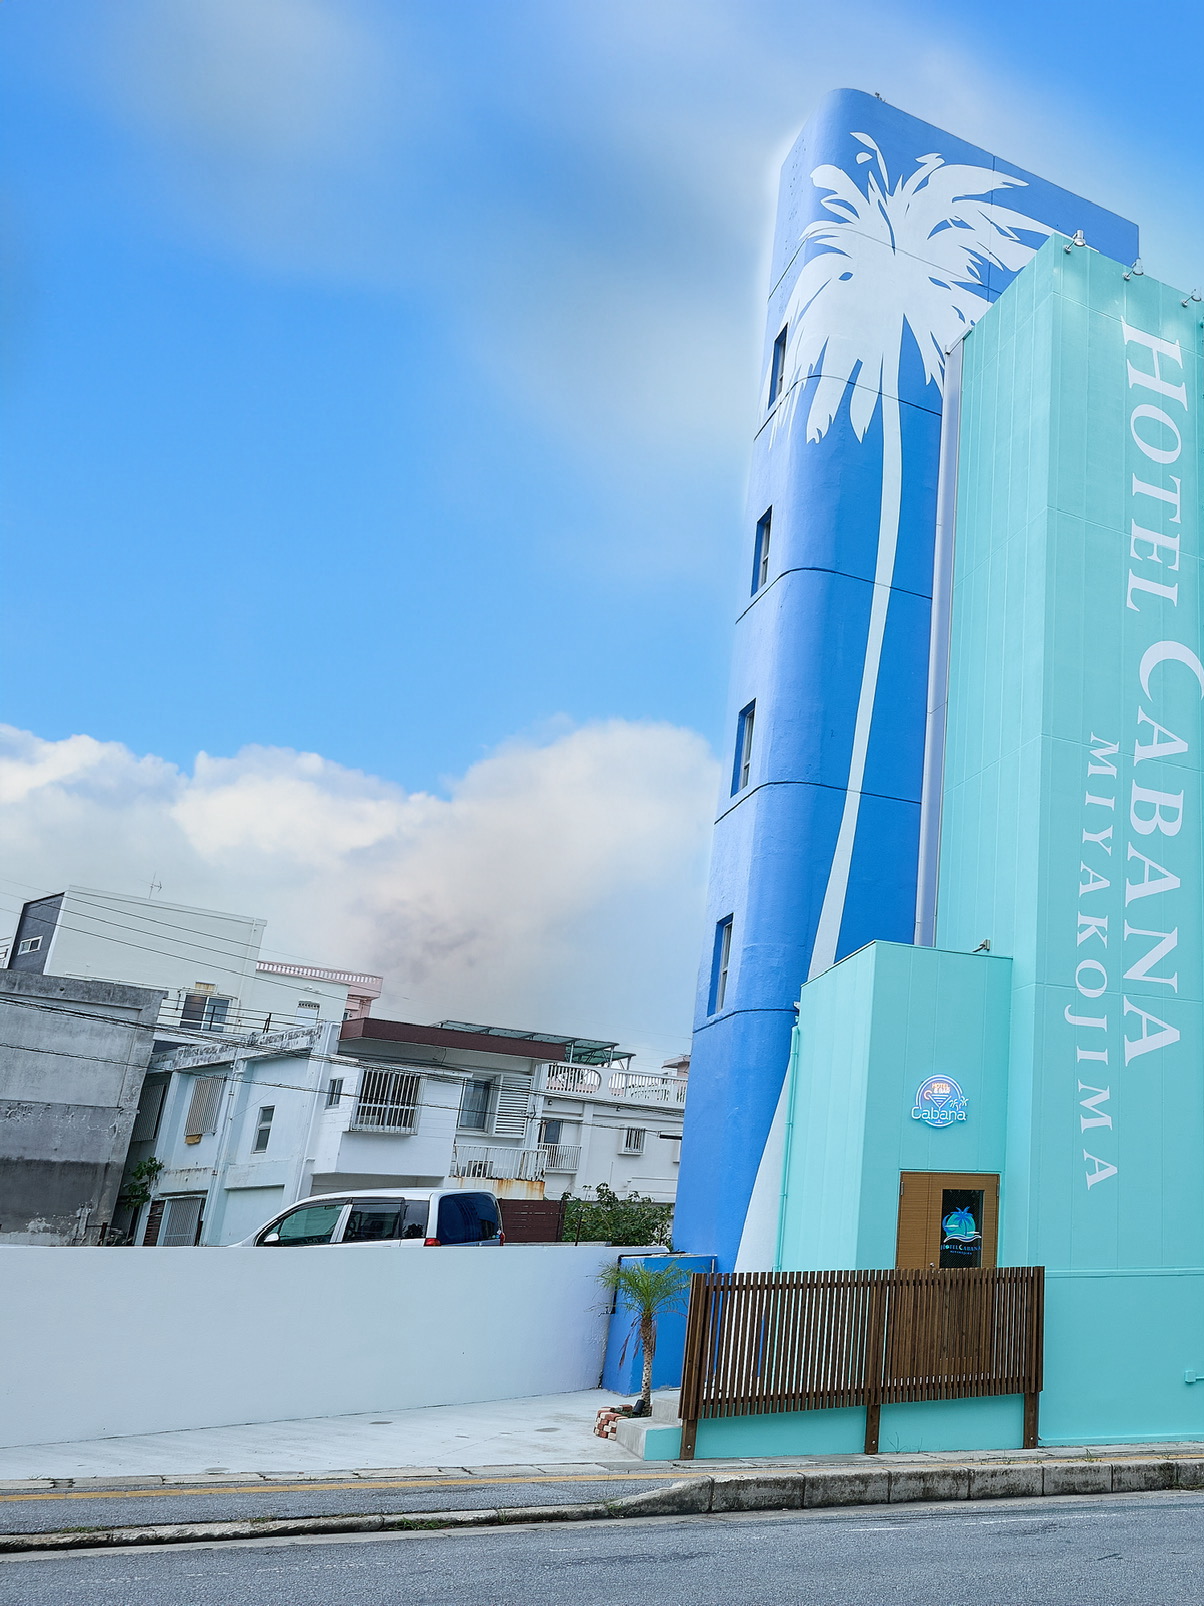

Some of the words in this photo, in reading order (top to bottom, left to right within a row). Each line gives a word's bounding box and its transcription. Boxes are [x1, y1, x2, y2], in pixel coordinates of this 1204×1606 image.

[1121, 316, 1188, 612] HOTEL
[1064, 731, 1119, 1190] MIYAKOJIMA
[911, 1106, 966, 1121] Cabana
